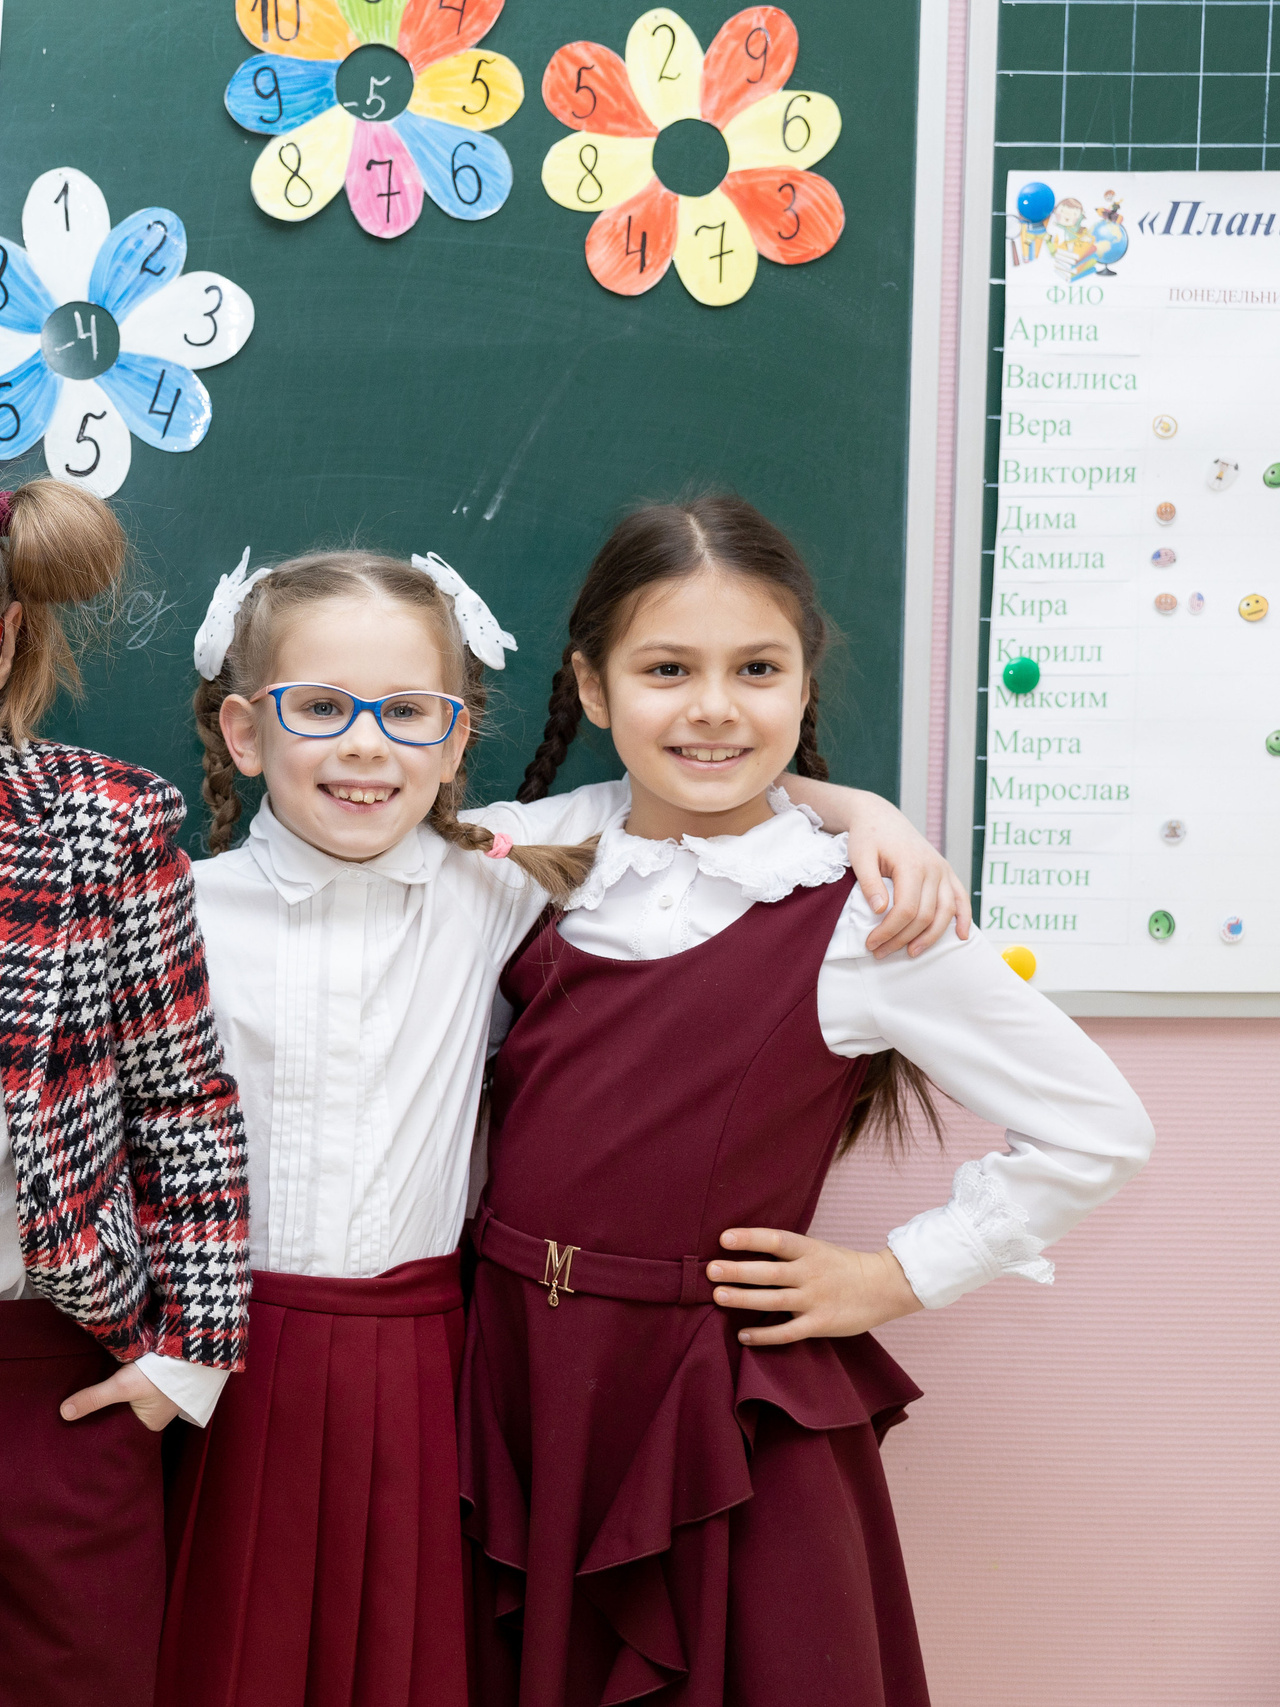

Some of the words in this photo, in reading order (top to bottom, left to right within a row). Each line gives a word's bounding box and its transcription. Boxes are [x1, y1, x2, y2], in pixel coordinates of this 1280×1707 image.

[251, 0, 301, 43] 10
[651, 24, 681, 82] 2
[745, 27, 771, 84] 9
[253, 66, 283, 124] 9
[461, 59, 497, 114] 5
[571, 64, 597, 119] 5
[782, 94, 812, 153] 6
[278, 142, 313, 208] 8
[366, 159, 401, 223] 7
[451, 141, 483, 206] 6
[576, 144, 603, 204] 8
[53, 180, 71, 232] 1
[777, 183, 801, 240] 3
[1137, 200, 1280, 237] «План
[140, 219, 168, 277] 2
[626, 215, 648, 274] 4
[694, 221, 734, 284] 7
[183, 285, 223, 347] 3
[1046, 285, 1105, 306] ФИО
[1008, 316, 1100, 348] Арина
[1005, 363, 1138, 391] Василиса
[148, 369, 182, 440] 4
[1006, 411, 1073, 443] Вера
[65, 411, 108, 477] 5
[1002, 459, 1137, 490] Виктория
[1000, 505, 1078, 532] Дима
[1000, 545, 1106, 570] Камила
[999, 593, 1068, 622] Кира
[996, 638, 1104, 664] Кирилл
[994, 684, 1109, 709] Максим
[993, 729, 1082, 760] Марта
[989, 776, 1131, 807] Мирослав
[990, 821, 1072, 846] Настя
[987, 861, 1091, 887] Платон
[984, 906, 1078, 931] Ясмин
